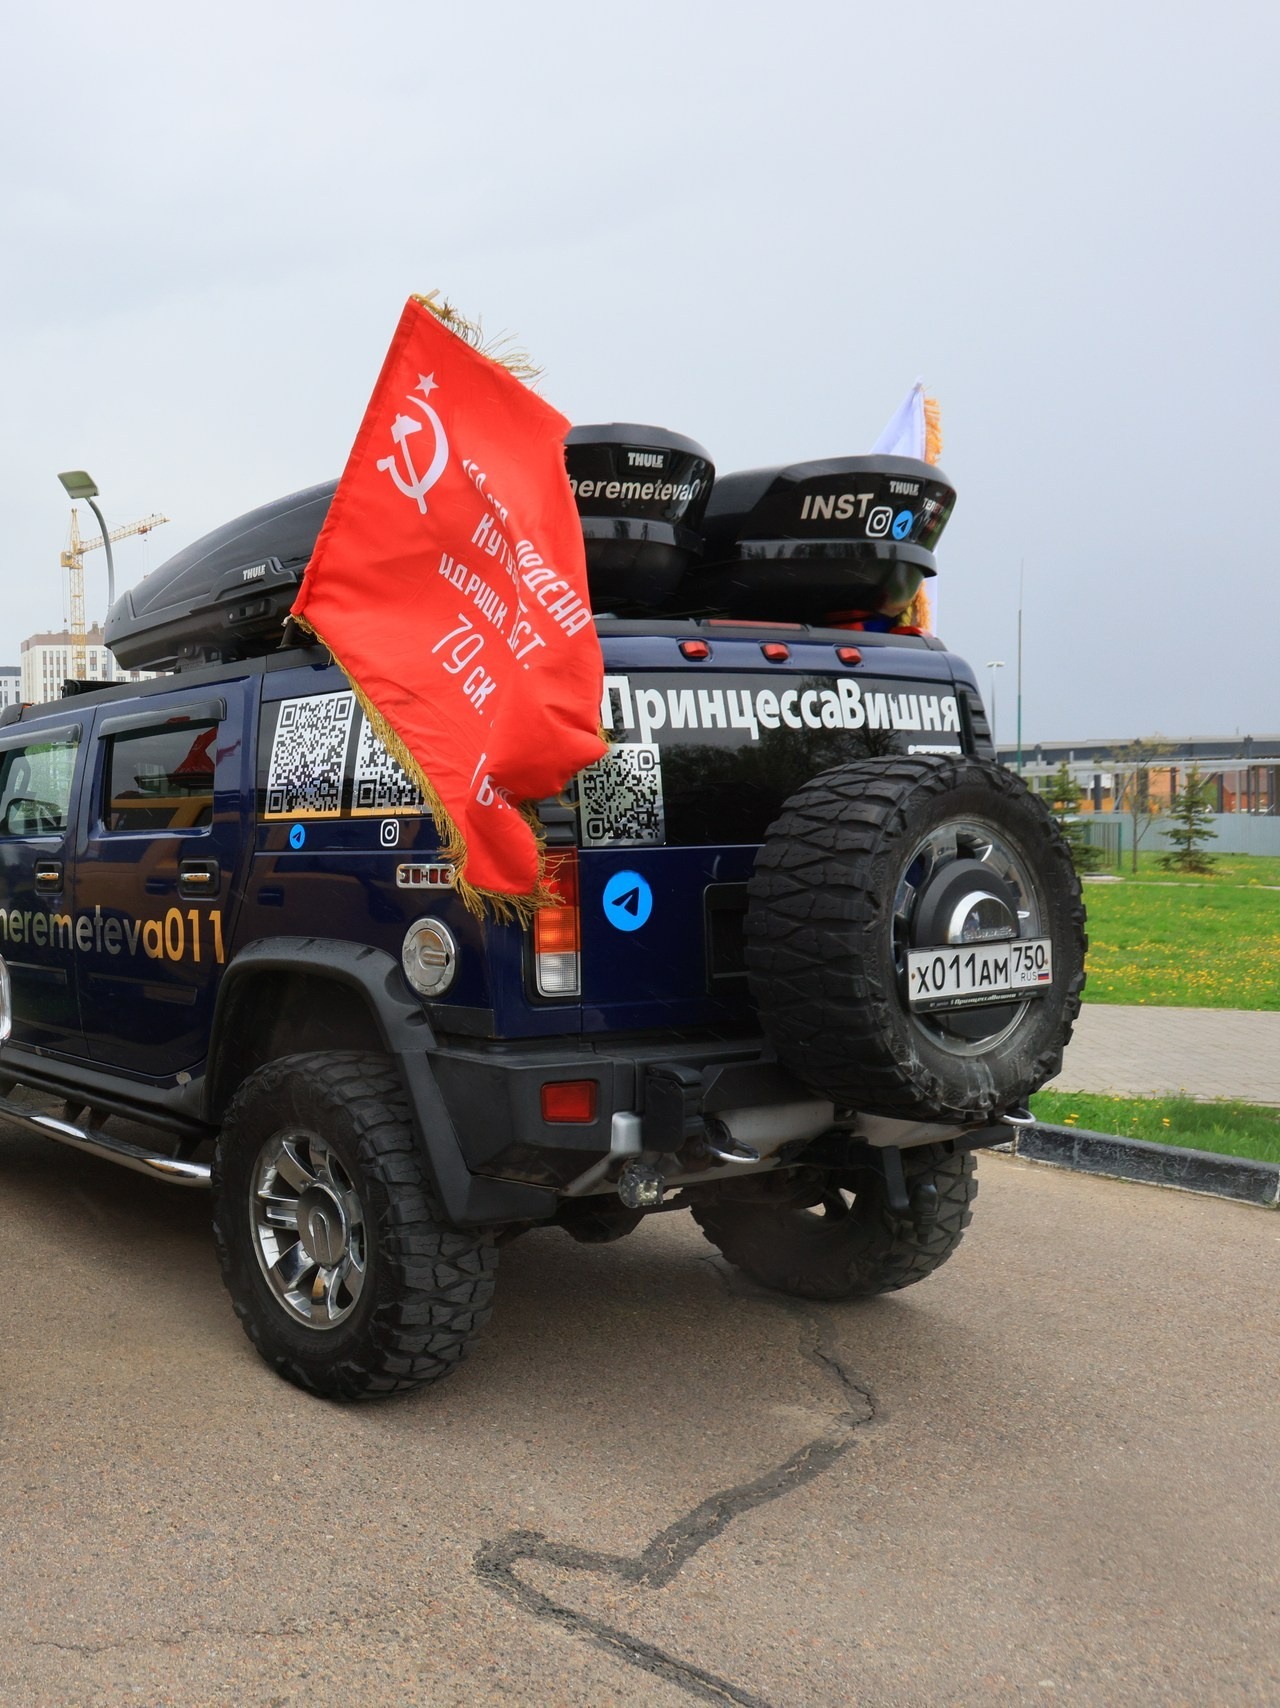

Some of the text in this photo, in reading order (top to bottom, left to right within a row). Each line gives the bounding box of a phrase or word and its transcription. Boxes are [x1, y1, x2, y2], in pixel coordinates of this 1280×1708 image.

[628, 452, 664, 468] THULE
[889, 480, 919, 496] THULE
[800, 493, 874, 519] INST
[242, 564, 266, 580] THULE
[431, 612, 497, 716] 79 СК.
[600, 675, 962, 744] ПринцессаВишня
[916, 944, 1045, 994] Х011АМ 750
[1021, 972, 1037, 982] RUS
